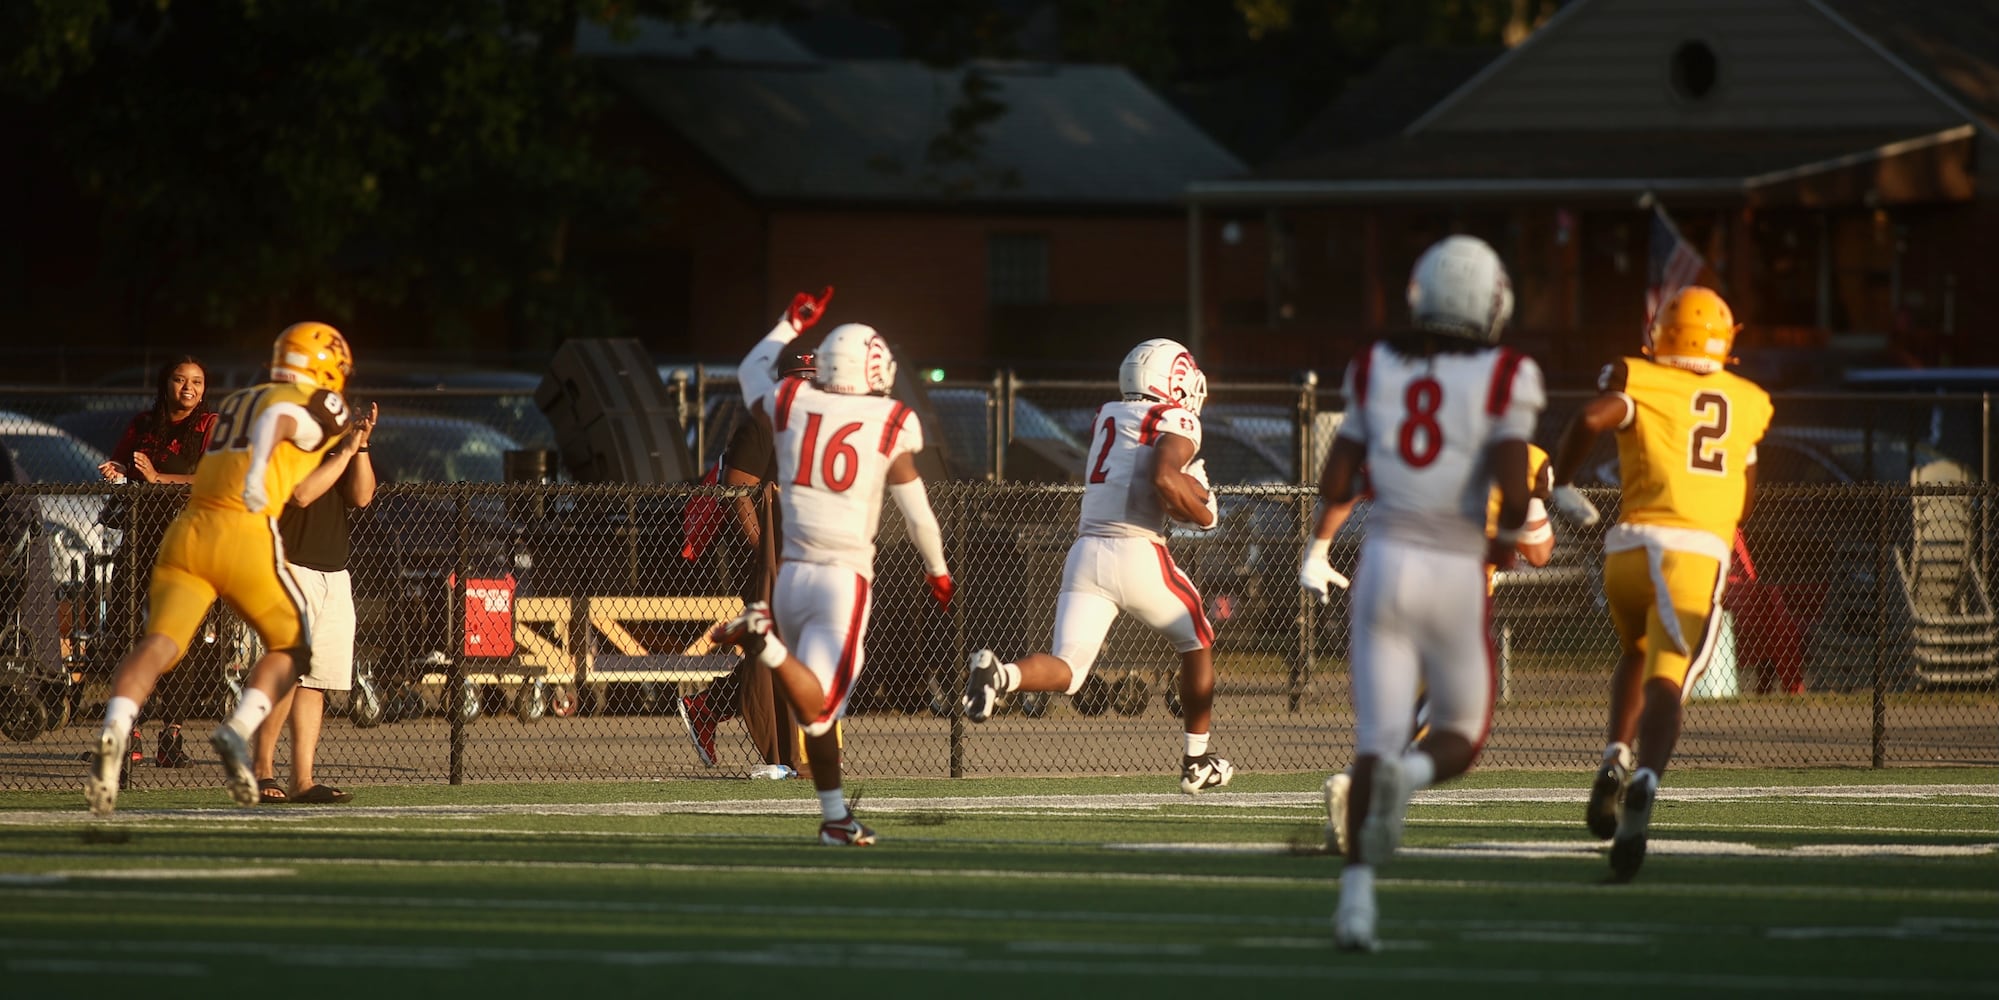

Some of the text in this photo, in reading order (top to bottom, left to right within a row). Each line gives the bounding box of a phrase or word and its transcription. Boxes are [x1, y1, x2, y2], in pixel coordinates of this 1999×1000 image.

[206, 388, 268, 453] 81
[792, 411, 863, 493] 16
[1089, 415, 1116, 484] 2
[1399, 376, 1444, 470] 8
[1689, 390, 1730, 476] 2
